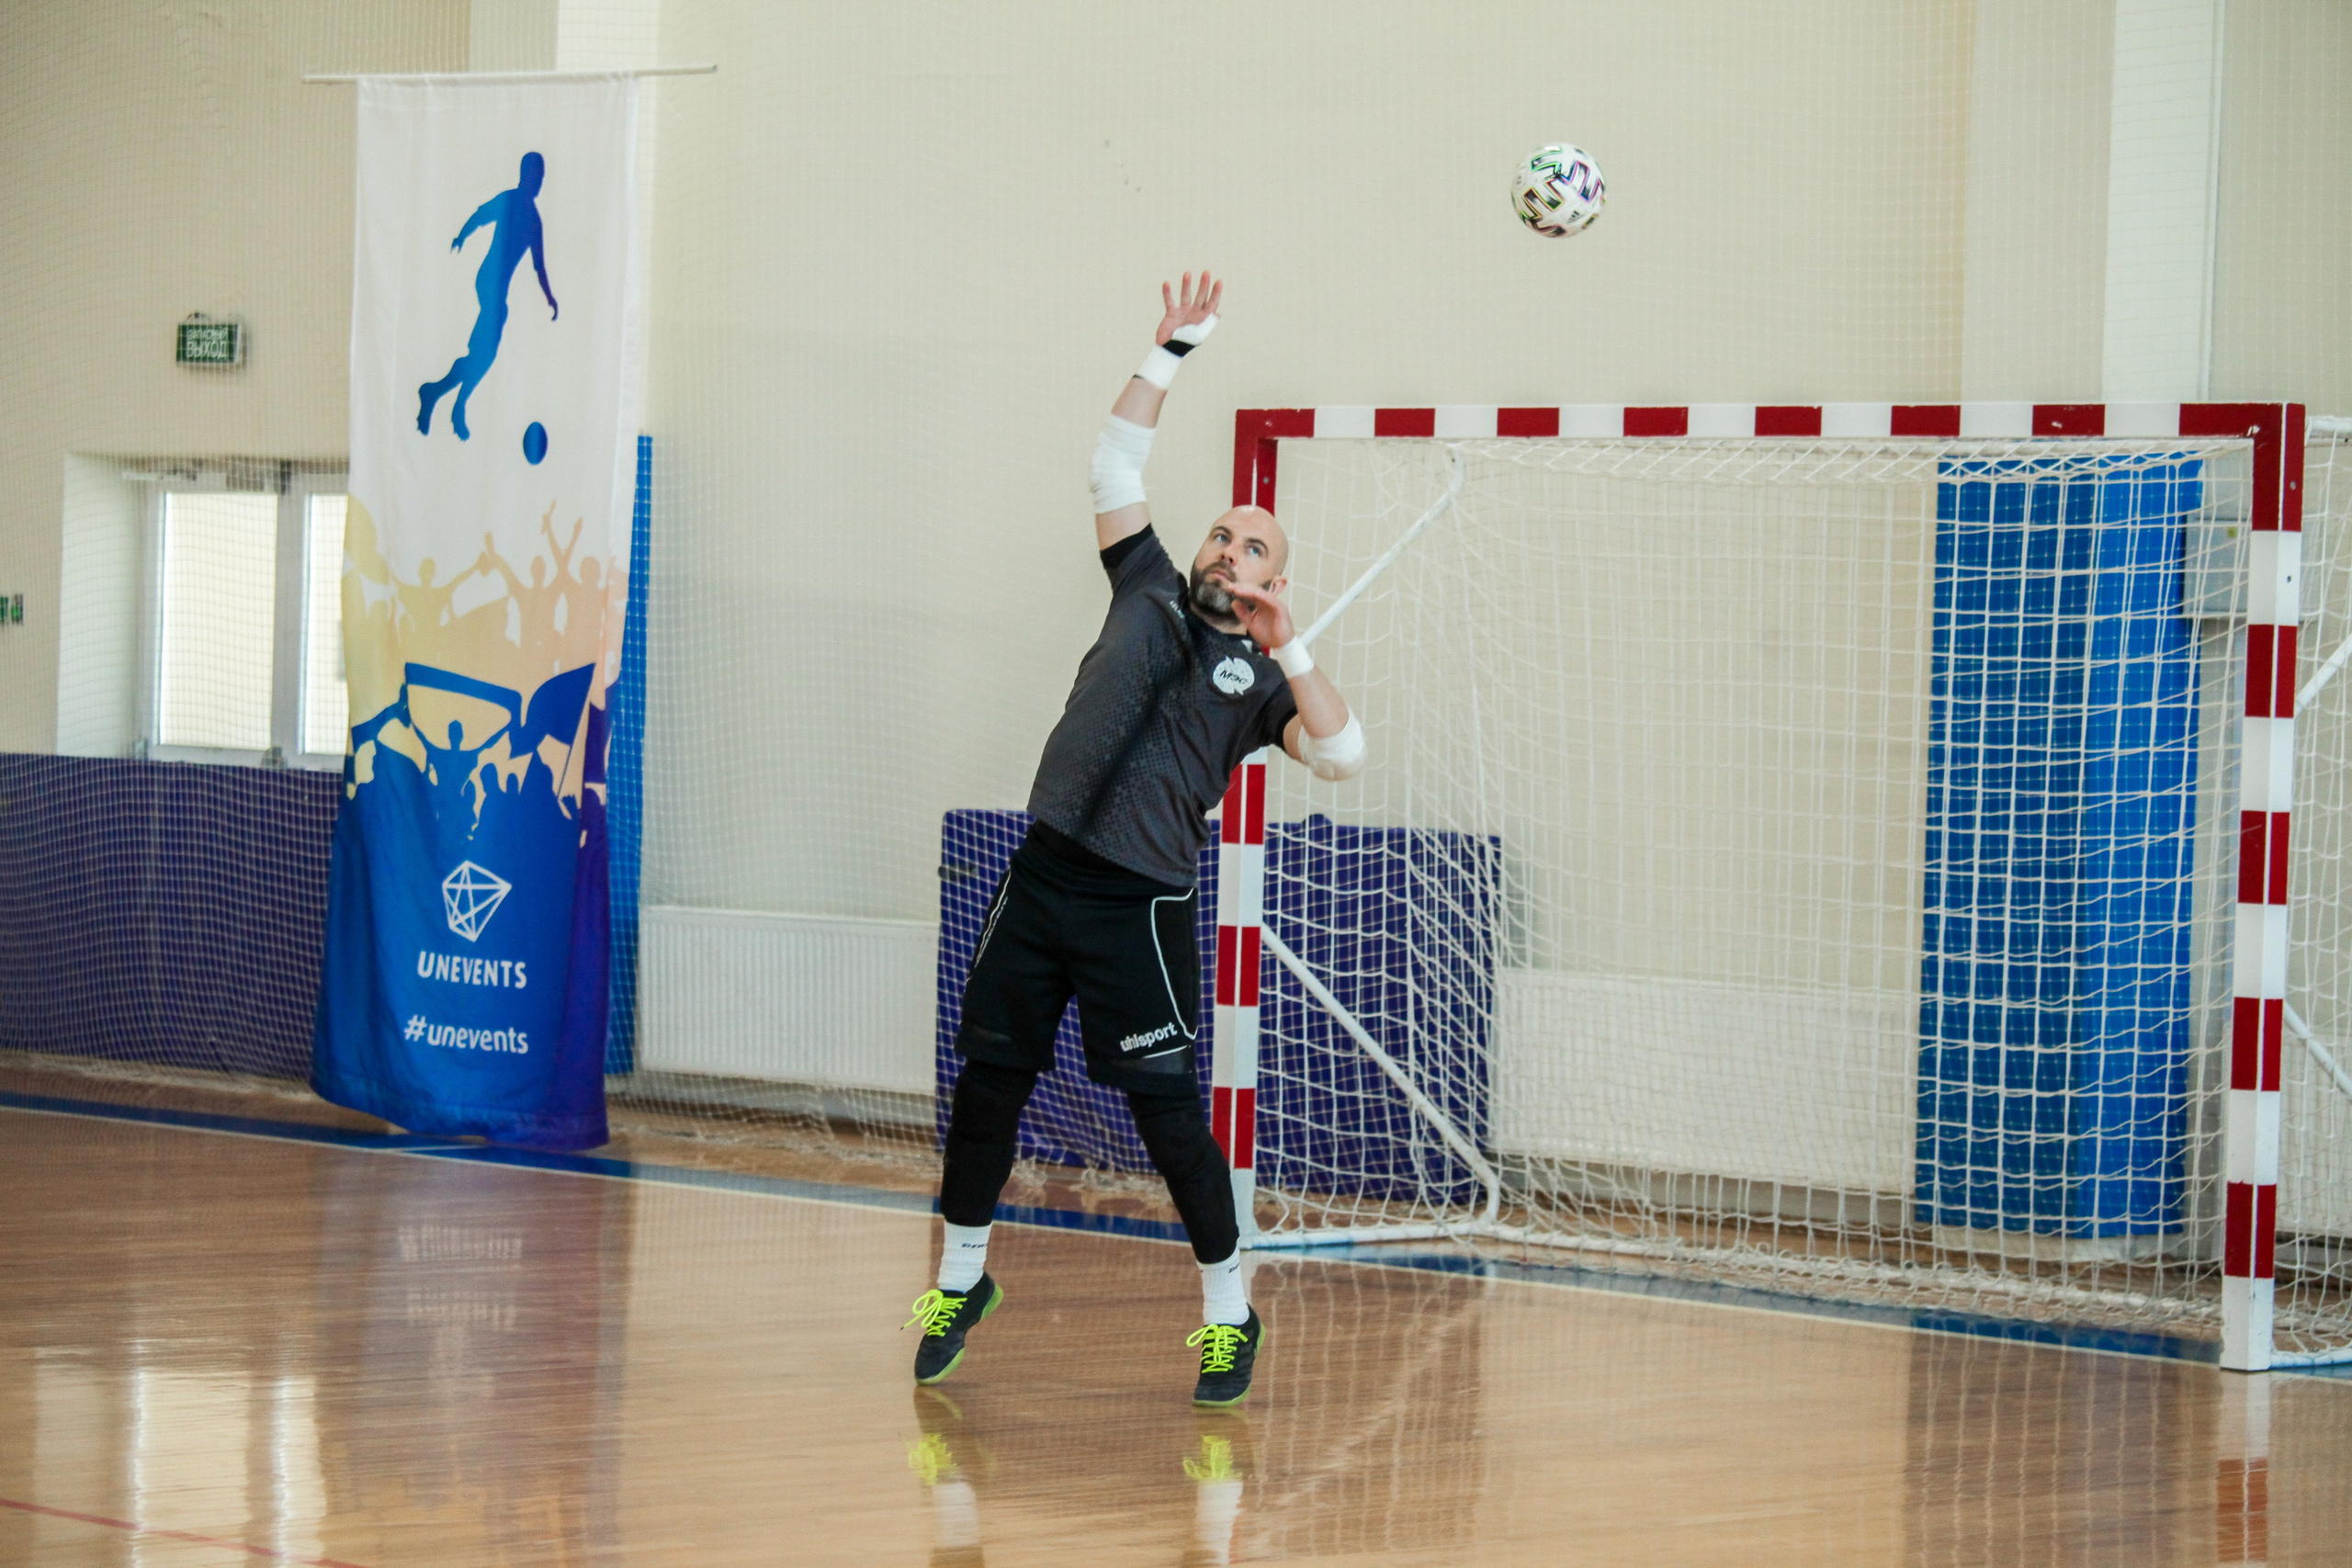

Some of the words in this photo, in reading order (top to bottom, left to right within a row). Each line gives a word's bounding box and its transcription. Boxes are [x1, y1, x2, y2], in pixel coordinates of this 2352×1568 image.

[187, 341, 229, 360] ВЫХОД
[416, 951, 527, 989] UNEVENTS
[404, 1014, 529, 1055] #unevents
[1120, 1021, 1178, 1053] uhlsport
